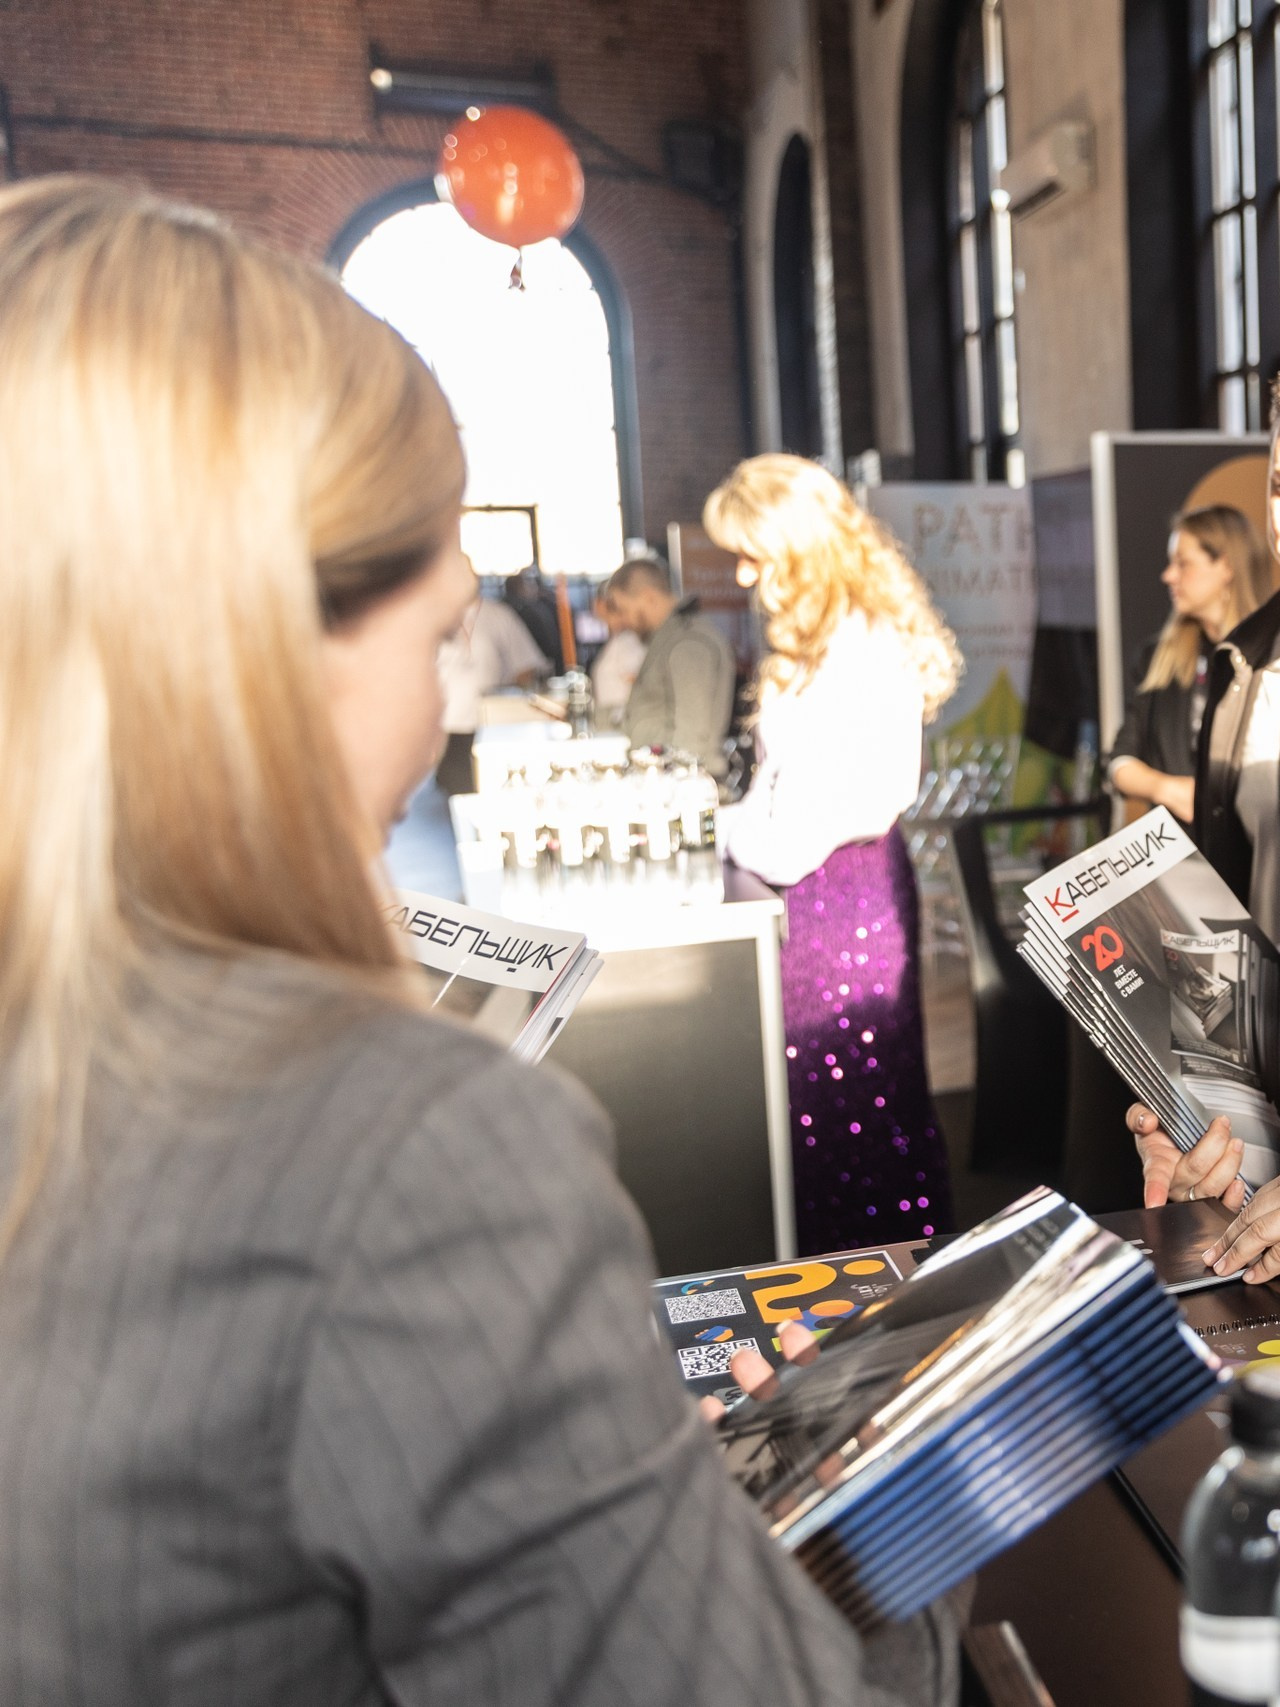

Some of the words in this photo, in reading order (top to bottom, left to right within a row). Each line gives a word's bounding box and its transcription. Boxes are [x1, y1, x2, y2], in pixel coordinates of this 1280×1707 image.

[1044, 822, 1177, 922] КАБЕЛЬЩИК
[386, 905, 569, 973] АБЕЛЬЩИК
[1081, 925, 1124, 971] 20
[1113, 964, 1127, 978] ЛЕТ
[1114, 968, 1139, 990] ВМЕСТЕ
[1120, 988, 1129, 998] С
